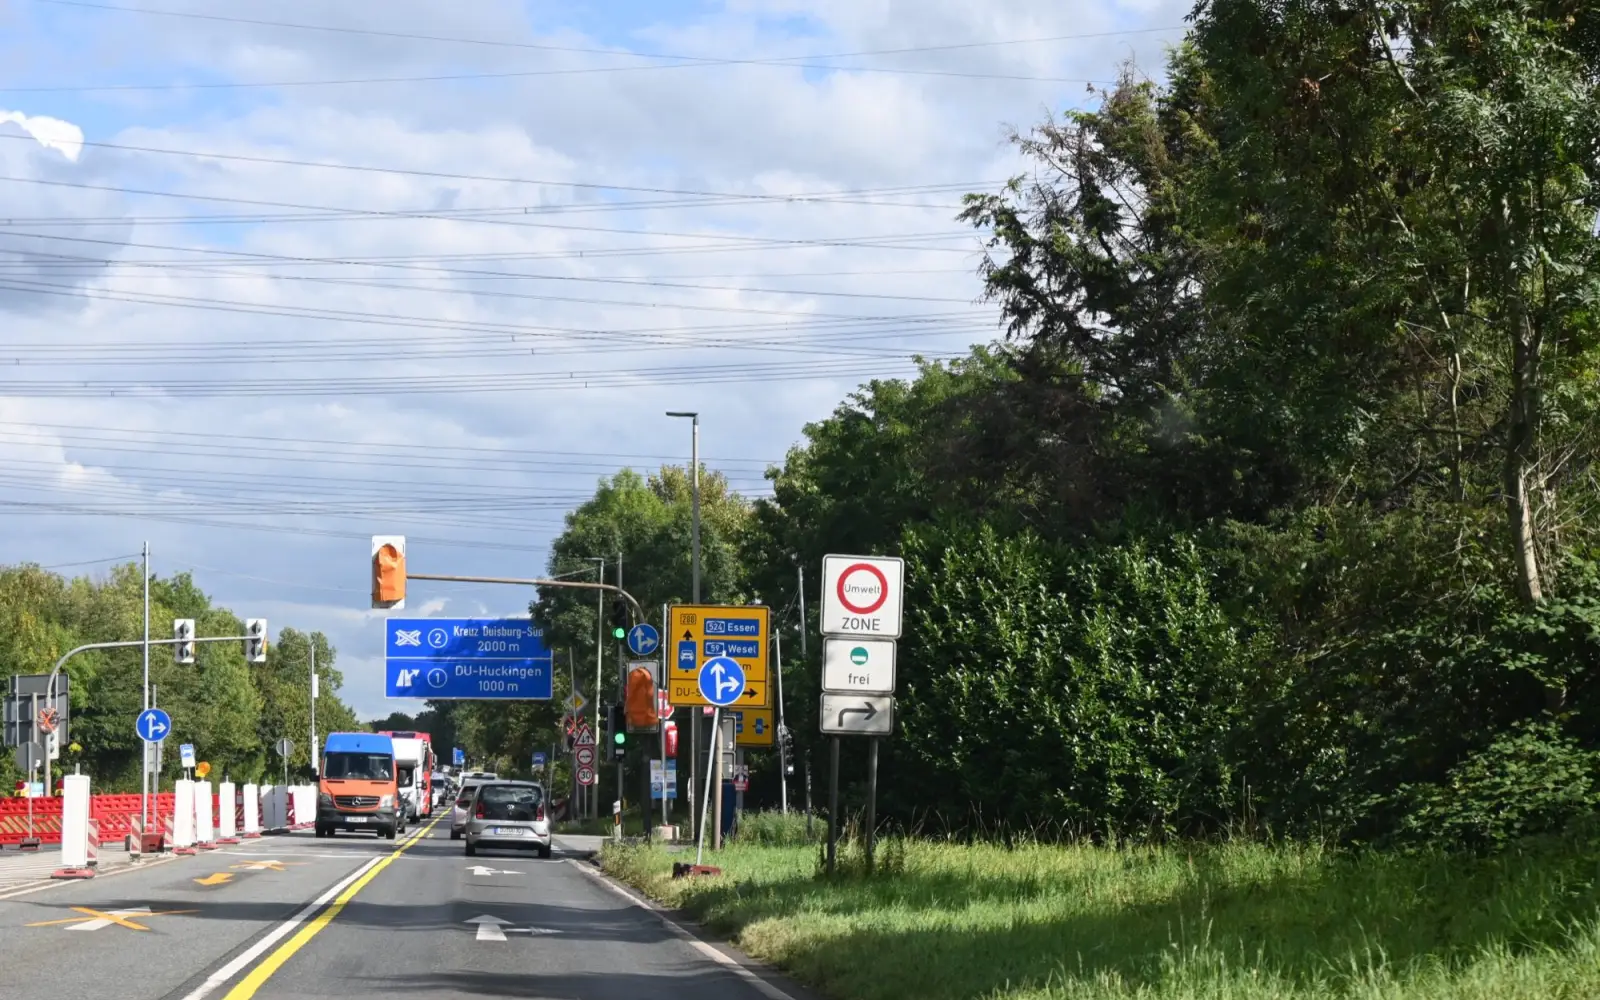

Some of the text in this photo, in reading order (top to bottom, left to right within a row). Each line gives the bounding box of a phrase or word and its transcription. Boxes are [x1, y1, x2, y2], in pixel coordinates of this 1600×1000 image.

[844, 583, 881, 594] Umwelt
[709, 623, 756, 632] 524 Essen
[841, 617, 881, 631] ZONE
[453, 626, 479, 637] Kreuz
[434, 633, 441, 644] 2
[478, 641, 520, 652] 2000 m
[728, 645, 757, 654] Wesel
[455, 665, 542, 679] DU-Huckingen
[435, 673, 440, 684] 1
[848, 673, 870, 685] frei
[478, 680, 519, 692] 1000 m
[580, 771, 591, 779] 30
